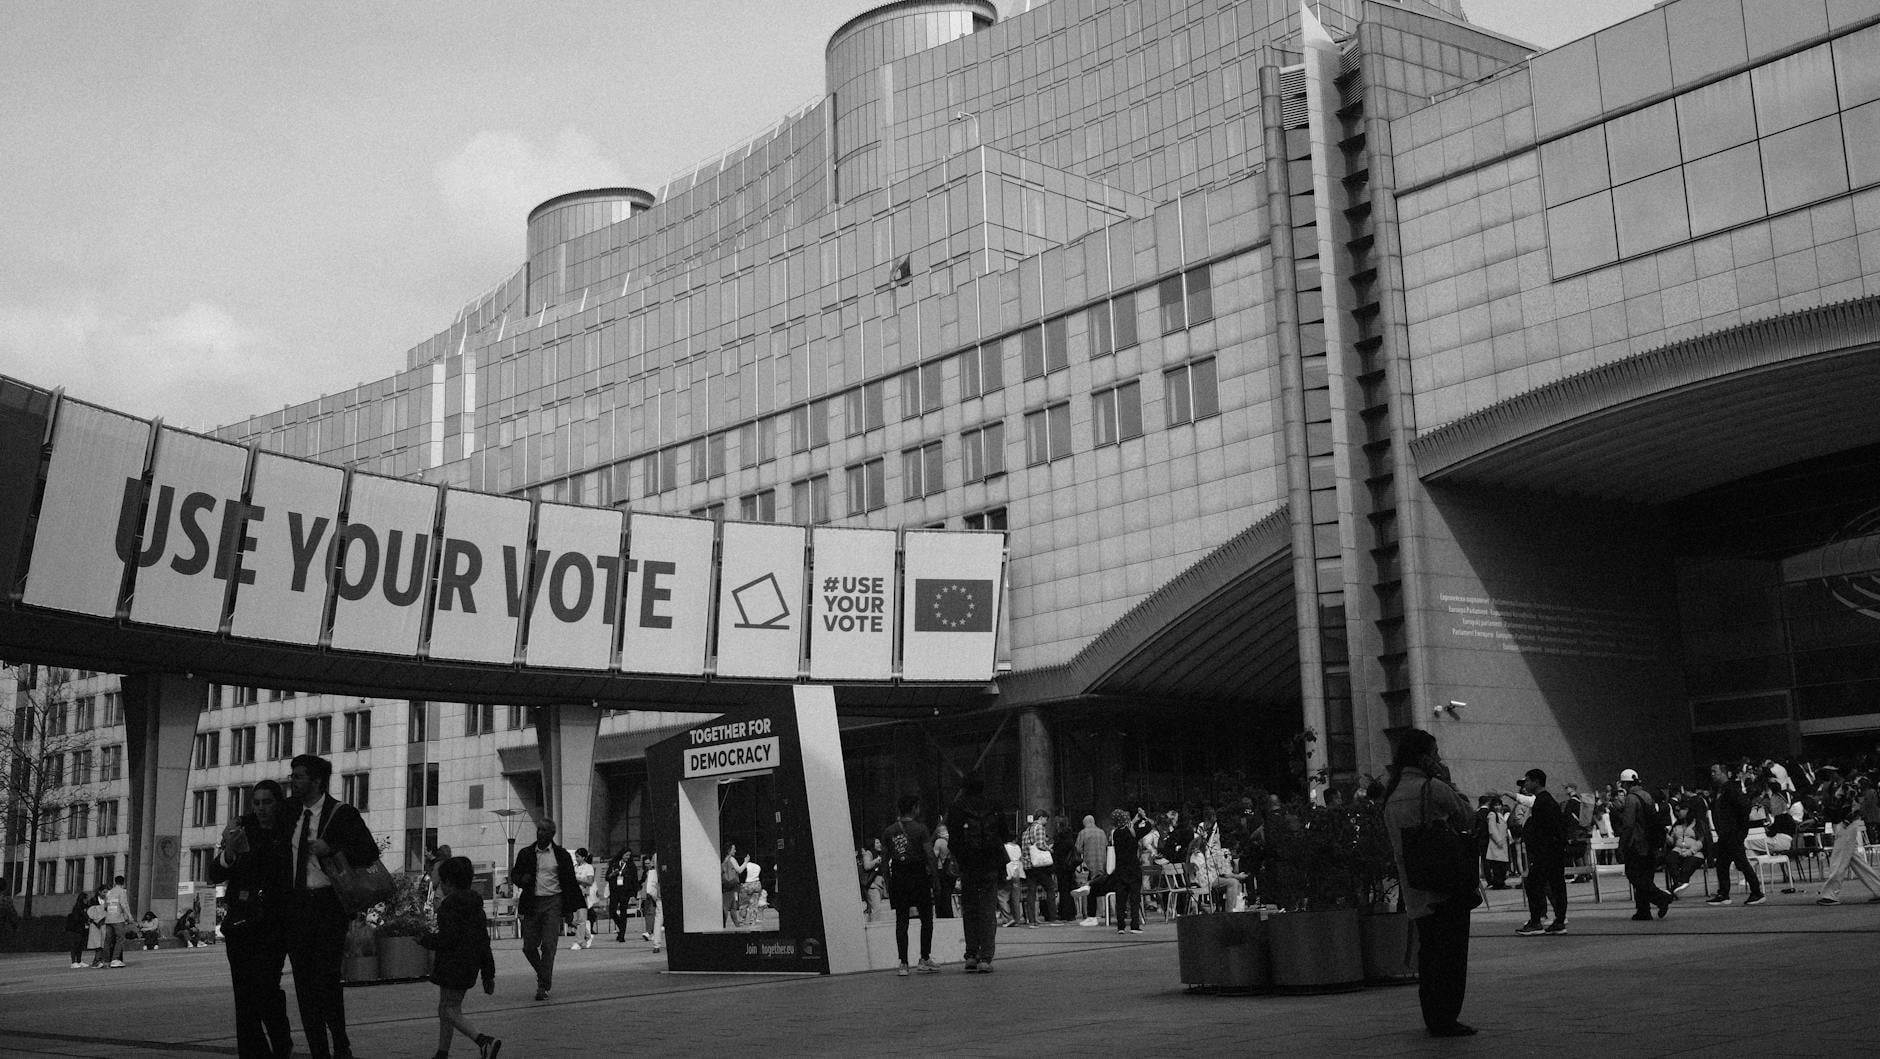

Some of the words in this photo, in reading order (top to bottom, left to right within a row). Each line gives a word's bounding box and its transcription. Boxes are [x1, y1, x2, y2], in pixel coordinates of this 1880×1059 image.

[115, 476, 265, 586] USE
[288, 511, 483, 614] YOUR
[502, 545, 676, 629] VOTE
[823, 576, 884, 594] #USE
[824, 595, 884, 613] YOUR
[823, 614, 883, 632] VOTE
[690, 723, 746, 744] TOGETHER
[748, 718, 771, 736] FOR
[691, 744, 771, 771] DEMOCRACY
[745, 943, 758, 955] Join
[761, 942, 795, 957] together.eu
